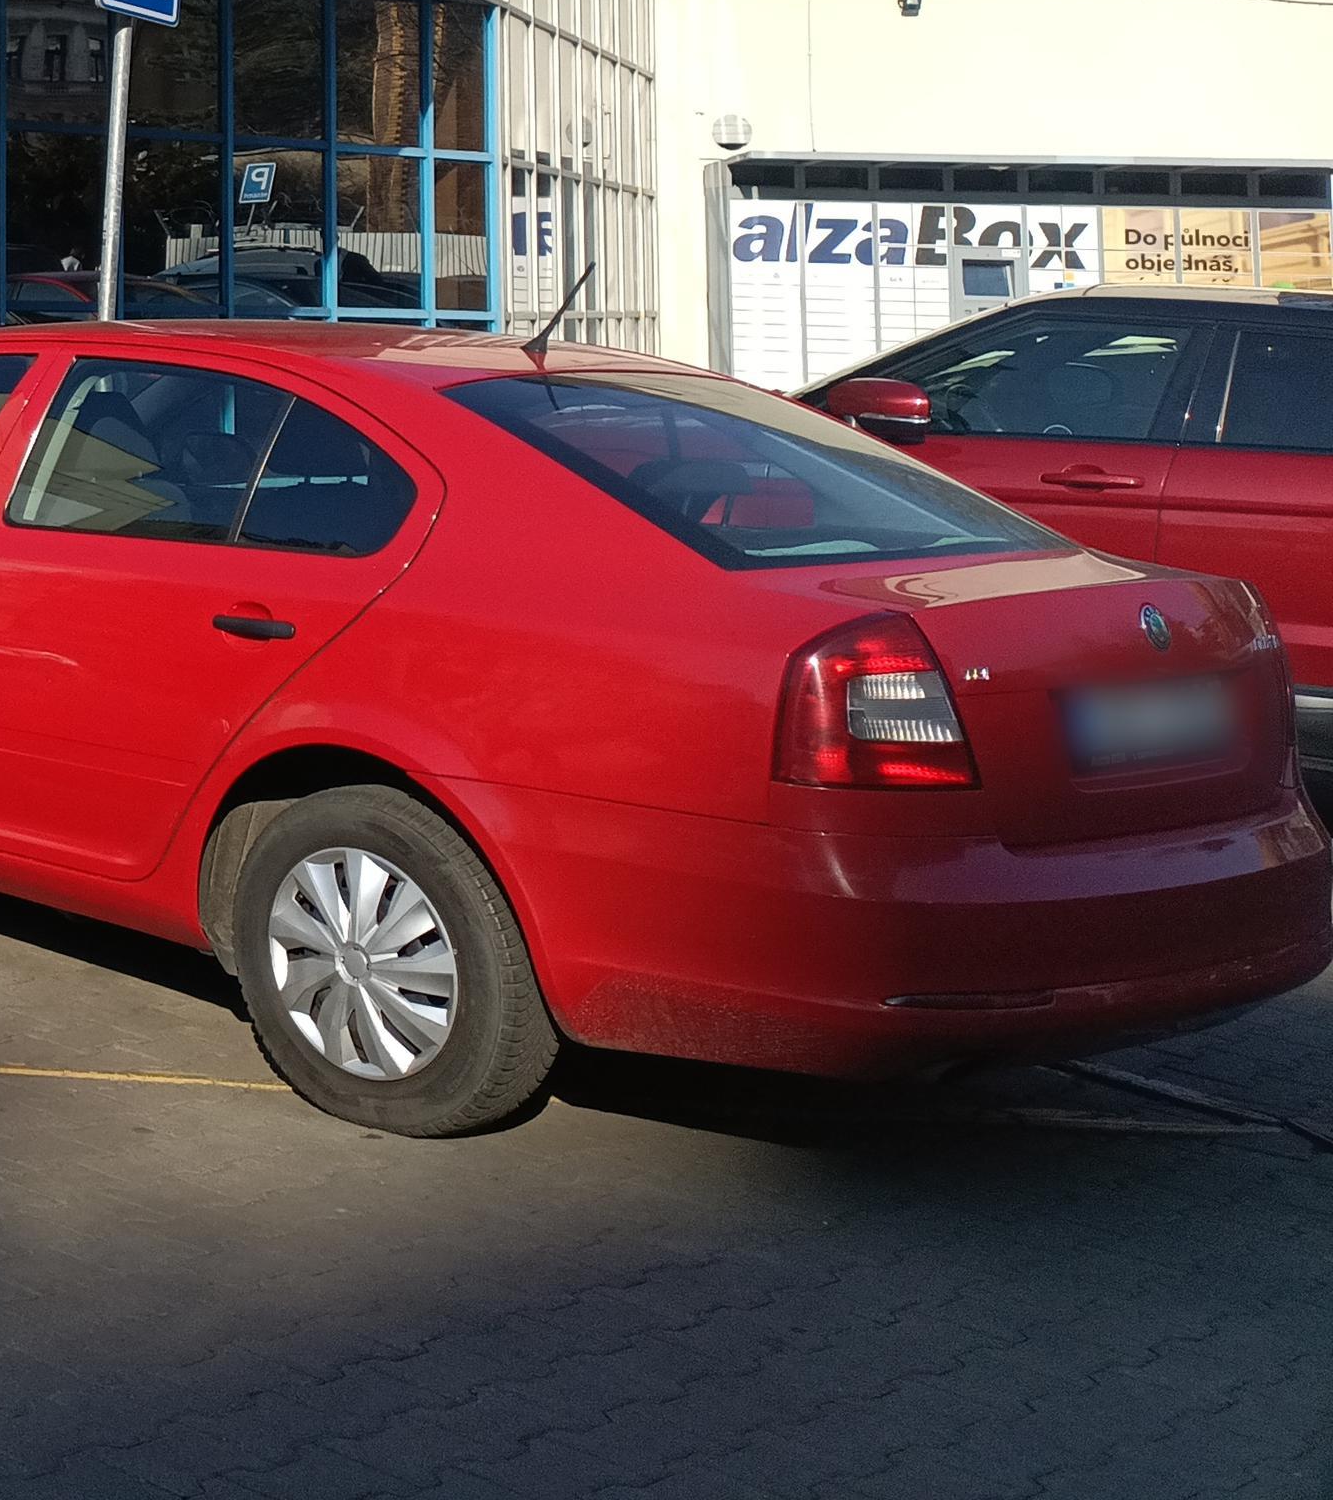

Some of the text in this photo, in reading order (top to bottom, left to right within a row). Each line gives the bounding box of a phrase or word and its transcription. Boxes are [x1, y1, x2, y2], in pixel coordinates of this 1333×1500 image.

[732, 202, 1089, 269] alzaBox
[1124, 228, 1249, 251] Do půlnoci
[1126, 254, 1239, 274] objednáš,
